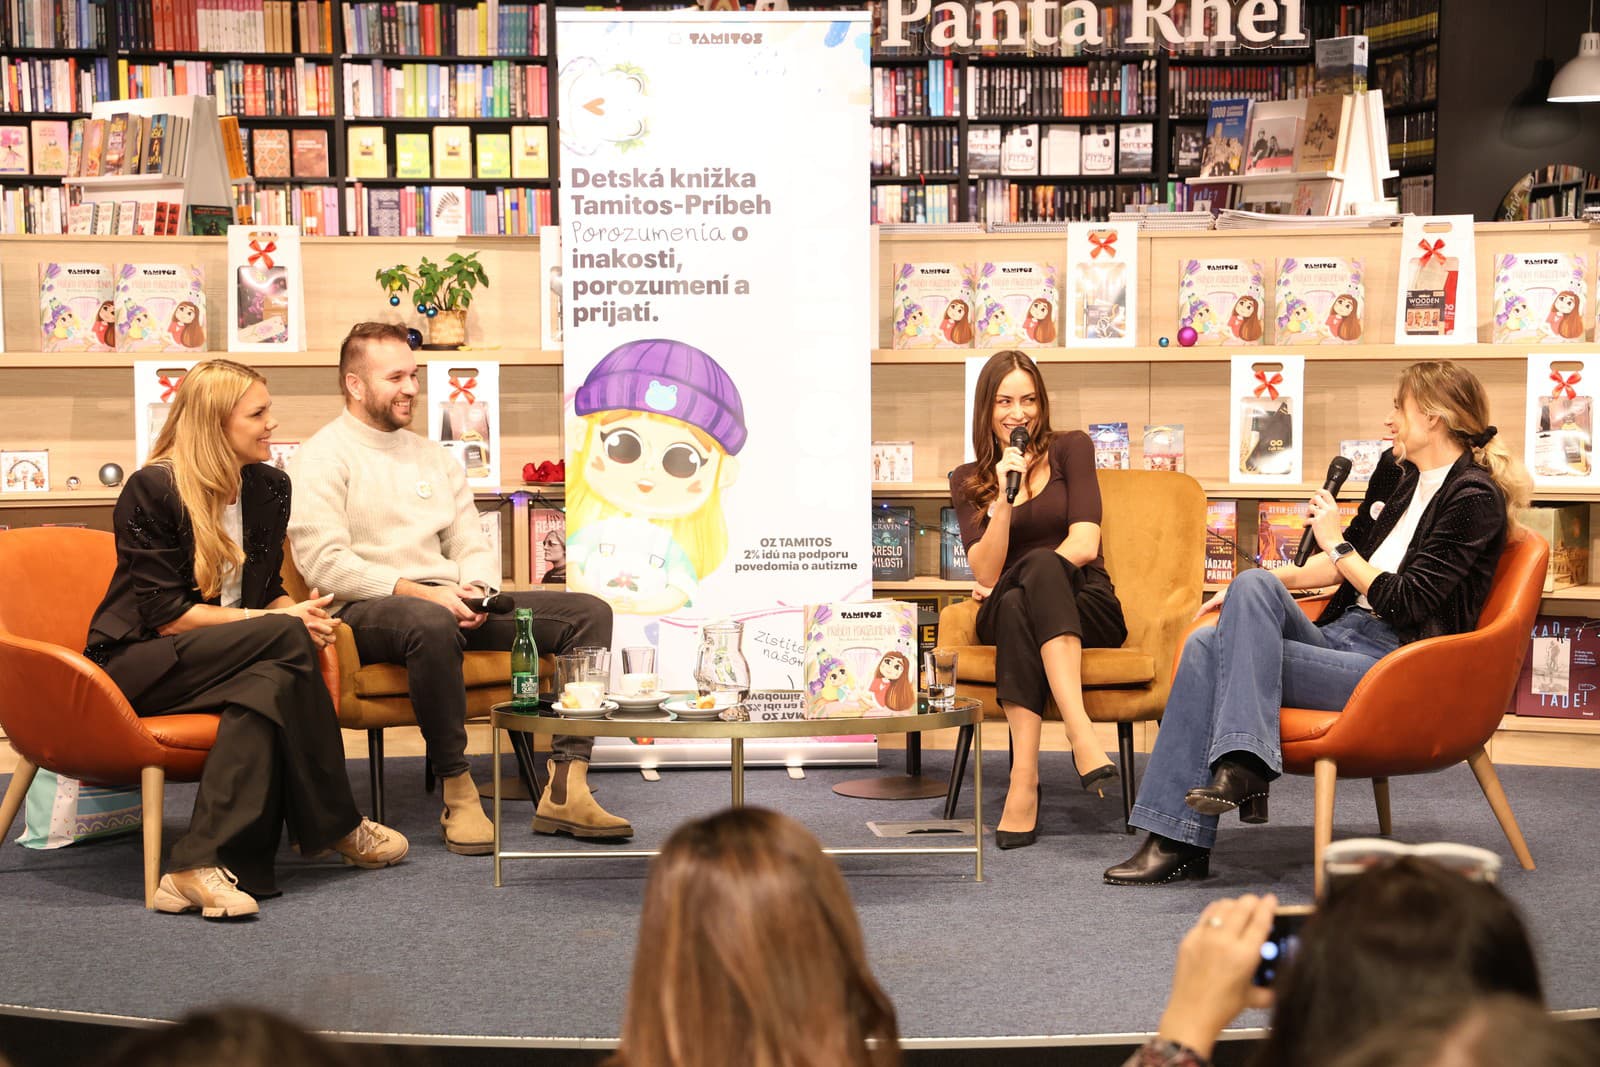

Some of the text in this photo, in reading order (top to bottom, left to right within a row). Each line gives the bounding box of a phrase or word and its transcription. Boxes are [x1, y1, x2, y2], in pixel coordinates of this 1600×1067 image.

[881, 0, 1307, 49] Panta Rhei
[689, 32, 763, 45] TAMITOS
[571, 167, 757, 188] Detská knižka
[571, 193, 772, 216] Tamitos-Príbeh
[732, 226, 748, 241] o
[572, 248, 683, 273] inakosti,
[572, 274, 750, 301] porozumení a
[573, 300, 660, 328] prijatí.
[760, 538, 833, 548] OZ TAMITOS
[744, 550, 760, 560] 2%
[762, 550, 780, 560] idú
[799, 550, 849, 562] podporu
[872, 545, 903, 556] KRESLO
[735, 561, 858, 574] povedomia o autizme
[872, 557, 904, 568] MILOSTI
[1262, 559, 1295, 569] PRECHÁ
[1206, 570, 1233, 580] PARKU
[841, 611, 882, 619] TAMITOS
[754, 630, 805, 654] Zistite
